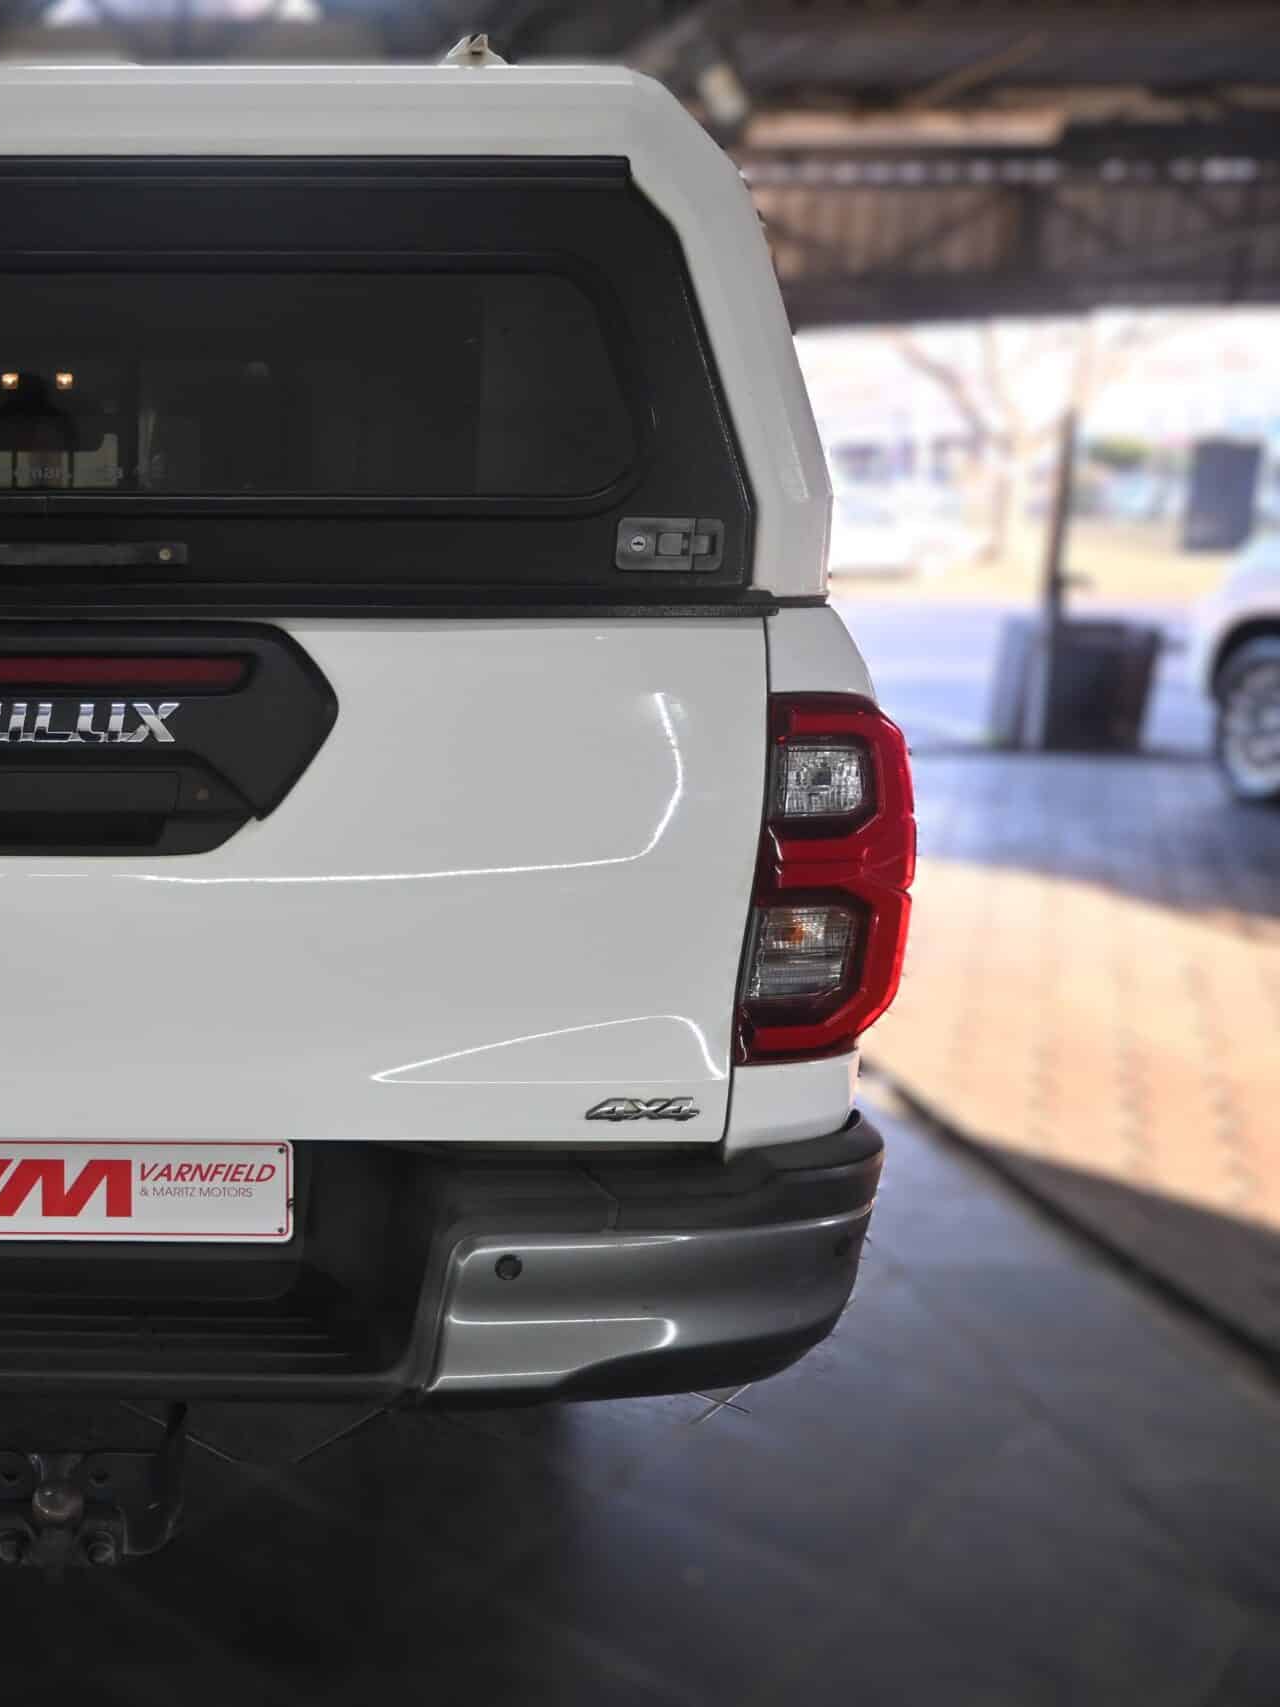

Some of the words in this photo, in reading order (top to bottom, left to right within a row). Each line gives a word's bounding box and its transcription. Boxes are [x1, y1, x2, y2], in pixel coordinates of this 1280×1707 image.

[140, 1162, 276, 1183] VARNFIELD
[140, 1186, 149, 1197] &
[152, 1186, 196, 1198] MARITZ
[199, 1186, 253, 1198] MOTORS
